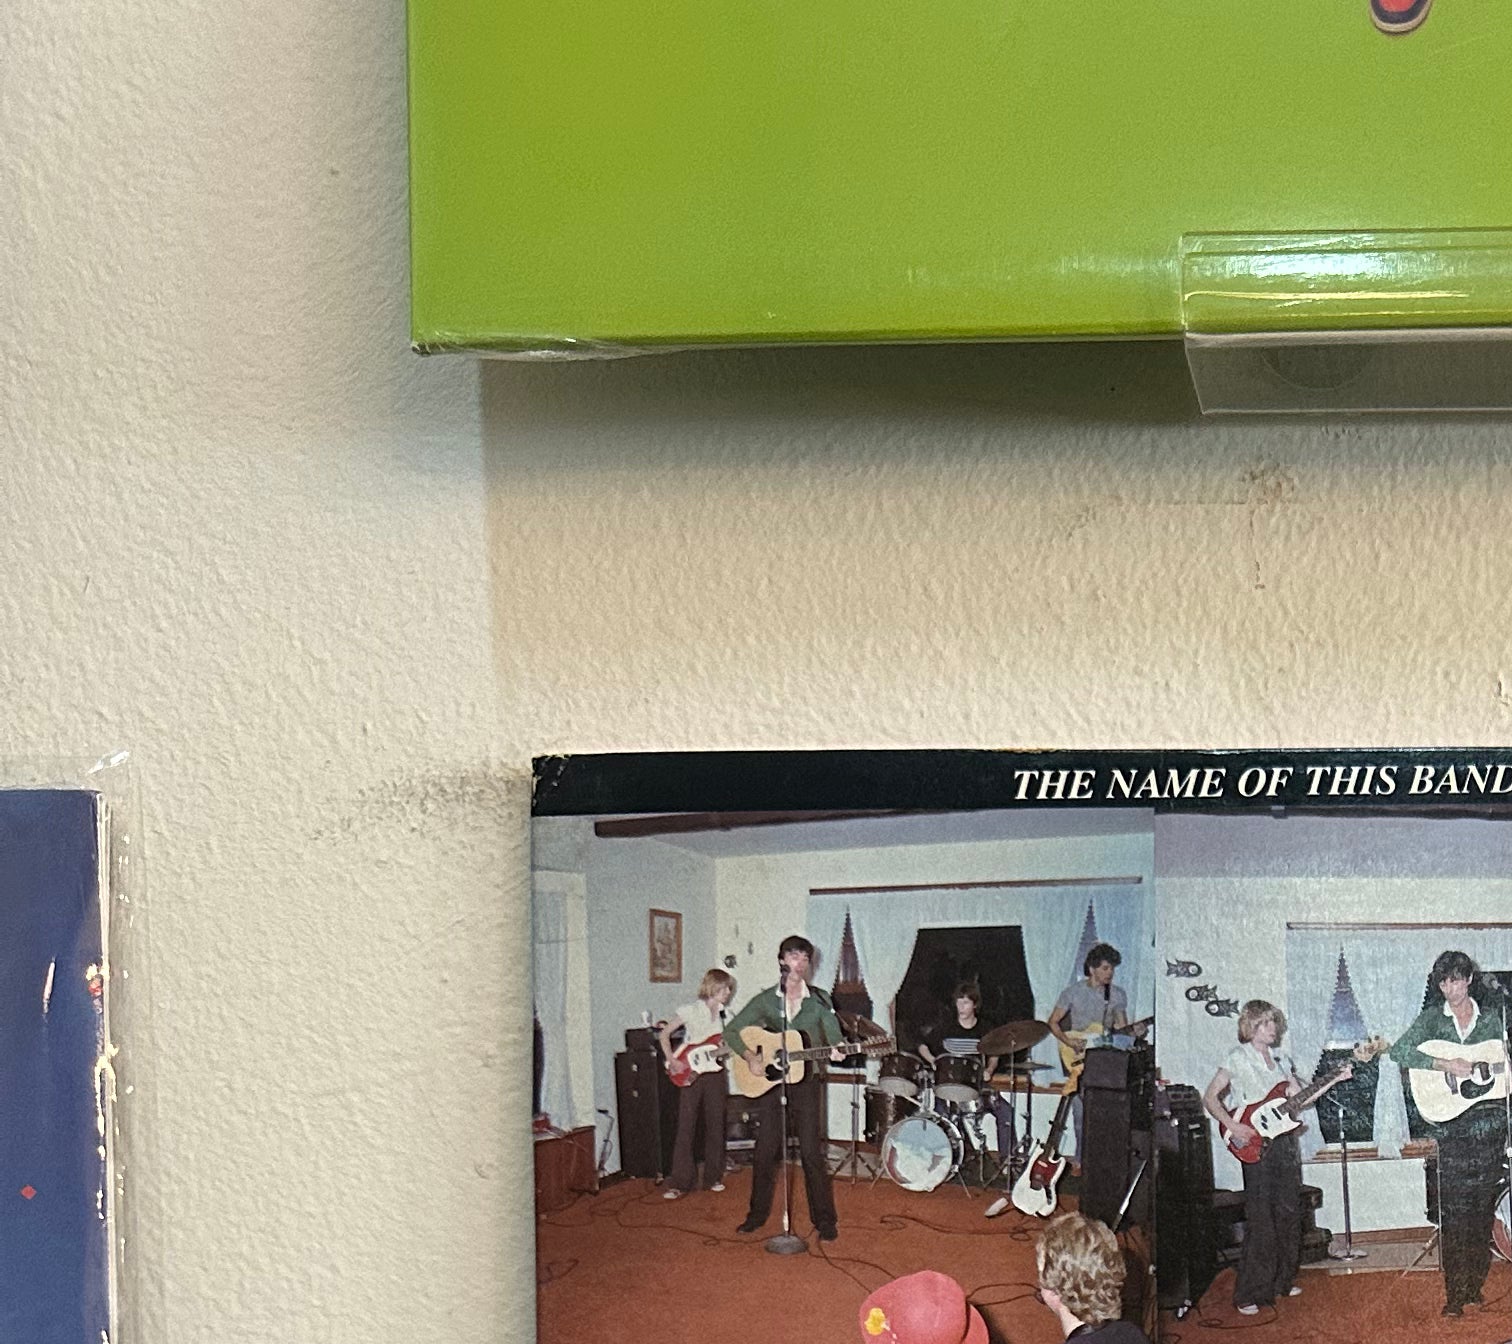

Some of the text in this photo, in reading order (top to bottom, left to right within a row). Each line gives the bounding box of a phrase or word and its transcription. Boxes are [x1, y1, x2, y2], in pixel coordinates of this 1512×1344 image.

[1014, 769, 1096, 800] THE
[1106, 768, 1226, 799] NAME
[1238, 767, 1294, 797] OF
[1305, 765, 1401, 797] THIS
